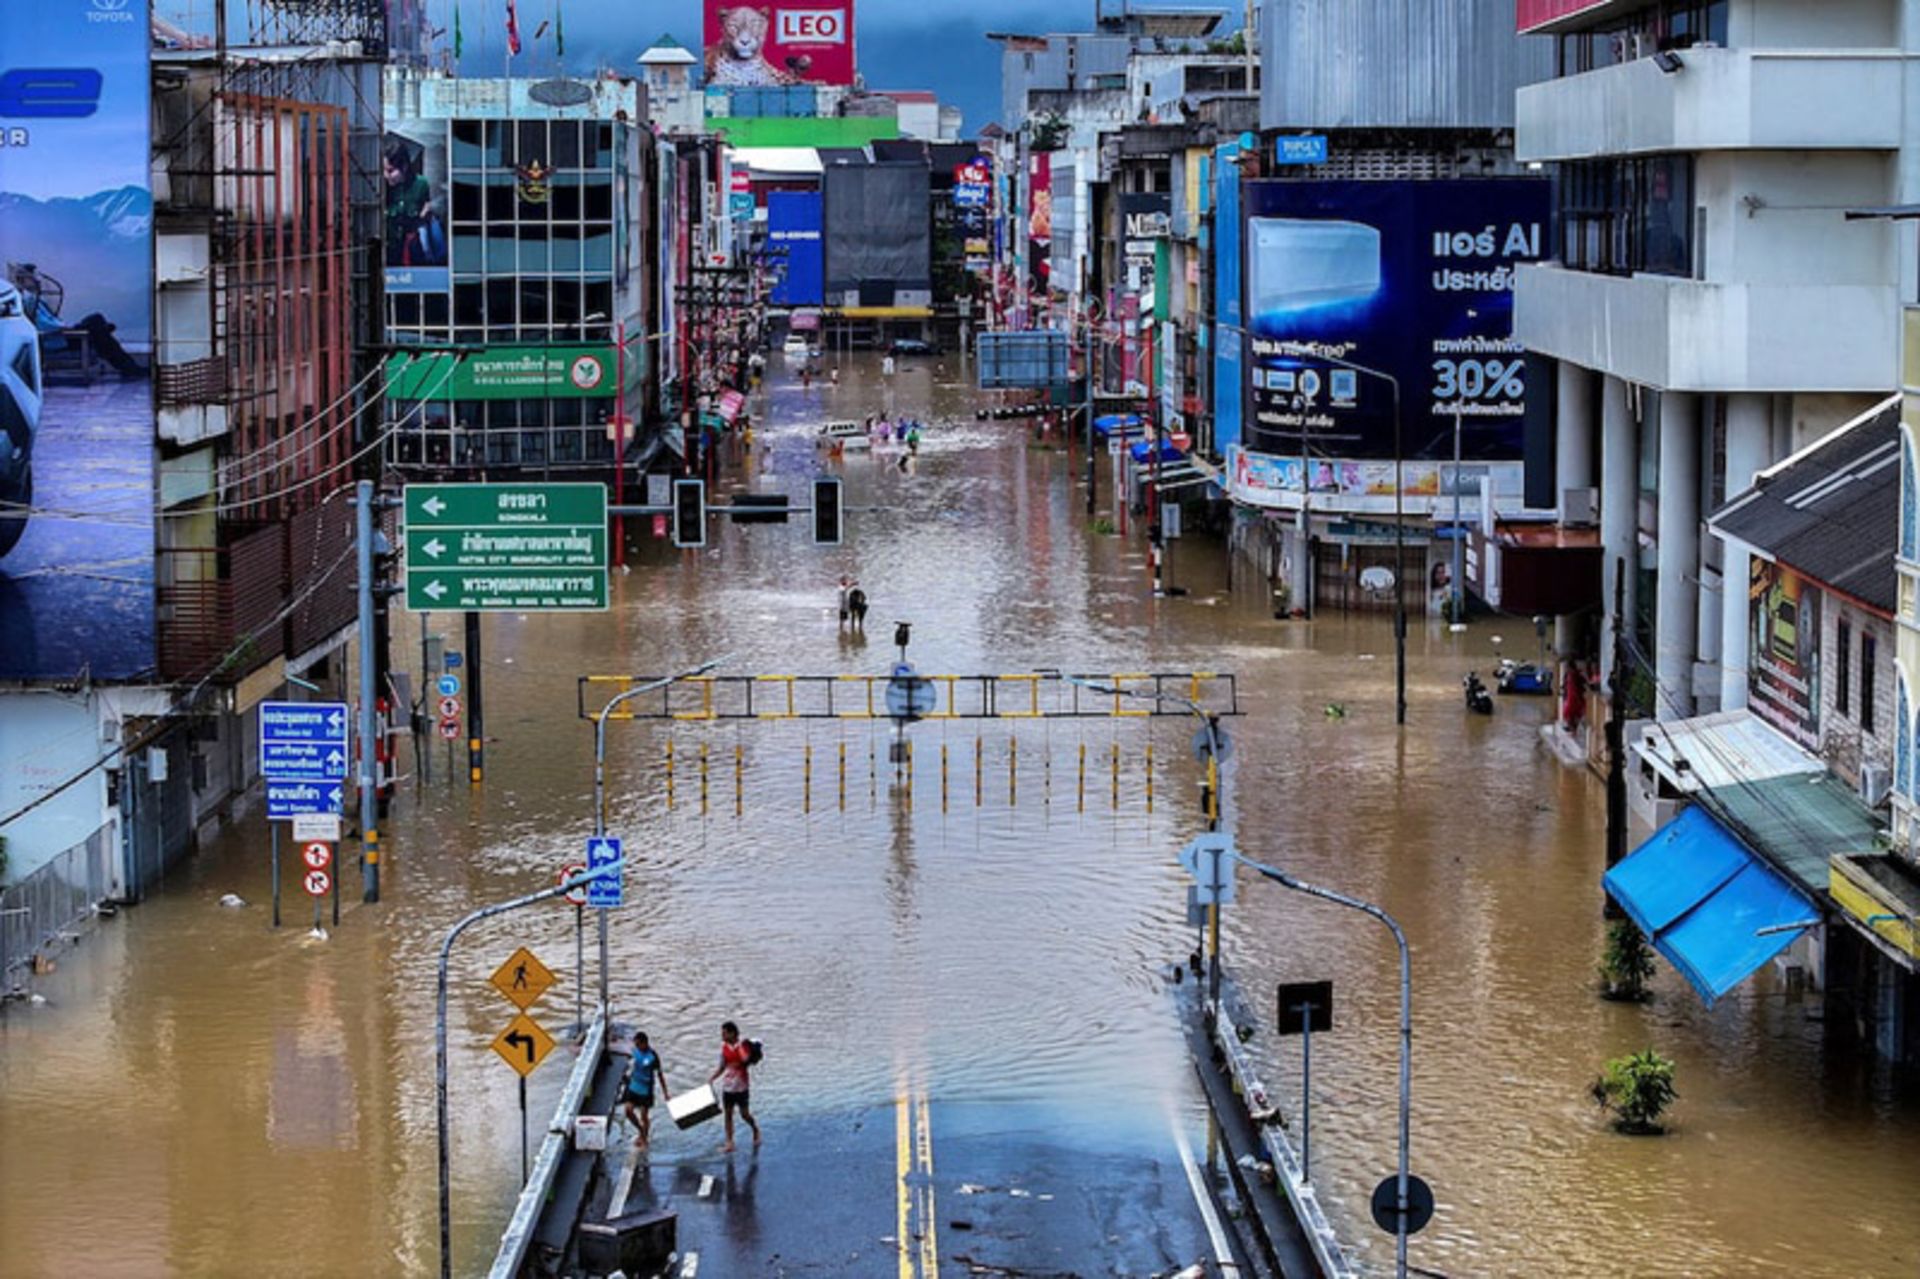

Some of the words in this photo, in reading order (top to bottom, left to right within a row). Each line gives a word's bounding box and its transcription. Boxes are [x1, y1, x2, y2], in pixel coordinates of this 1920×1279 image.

[86, 11, 134, 22] TOYOTA
[784, 15, 837, 37] LEO
[1433, 225, 1496, 257] แอร์
[1502, 222, 1541, 257] AI
[1432, 359, 1525, 399] 30%
[497, 493, 546, 508] สงขลา
